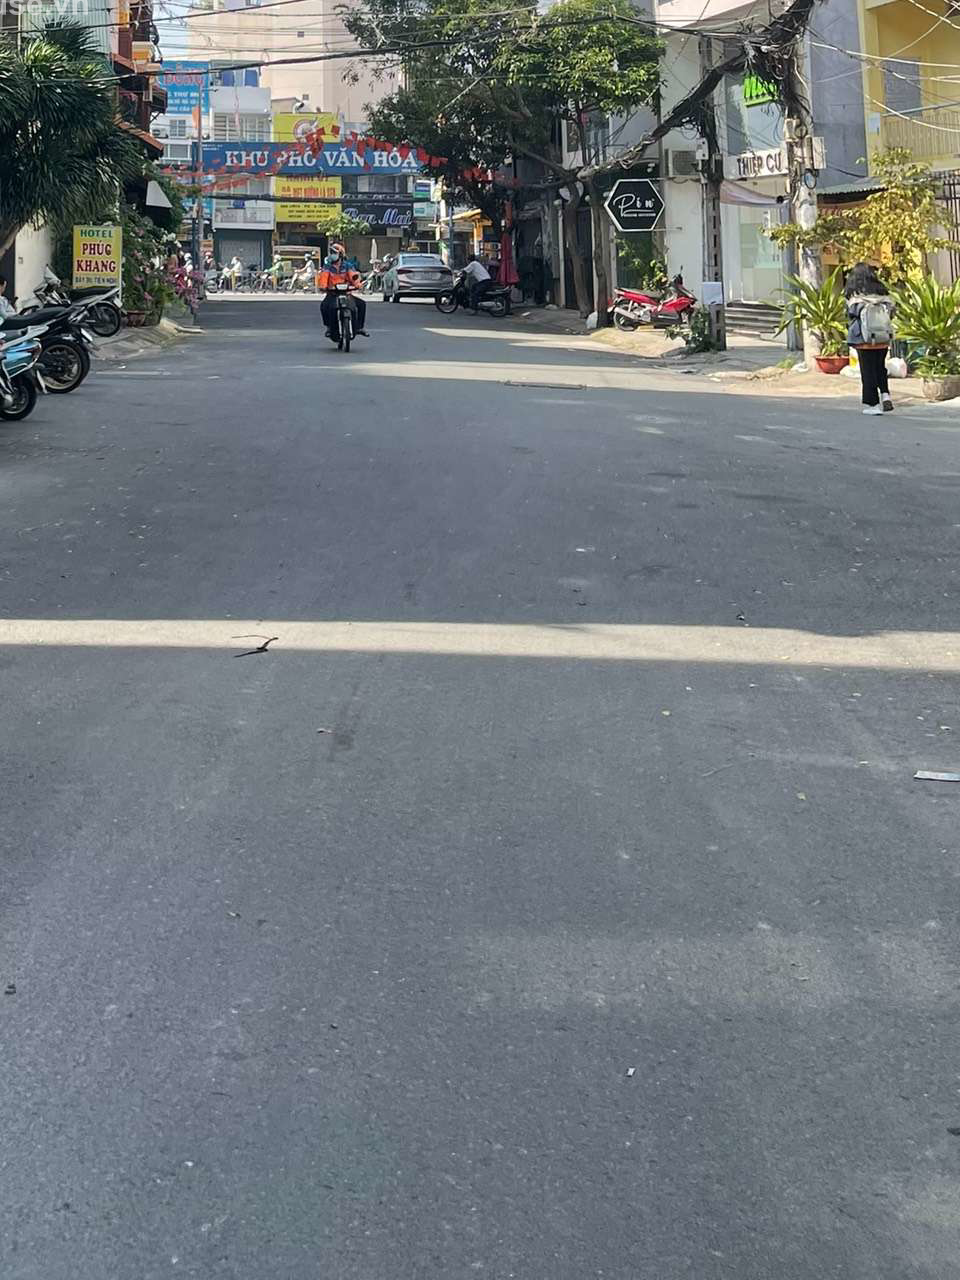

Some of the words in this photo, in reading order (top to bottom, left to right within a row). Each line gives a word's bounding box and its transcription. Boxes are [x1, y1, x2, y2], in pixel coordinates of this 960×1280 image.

[224, 150, 270, 167] KHU
[324, 147, 366, 167] VĂN
[80, 229, 113, 238] HOTEL
[76, 259, 117, 273] KHANG
